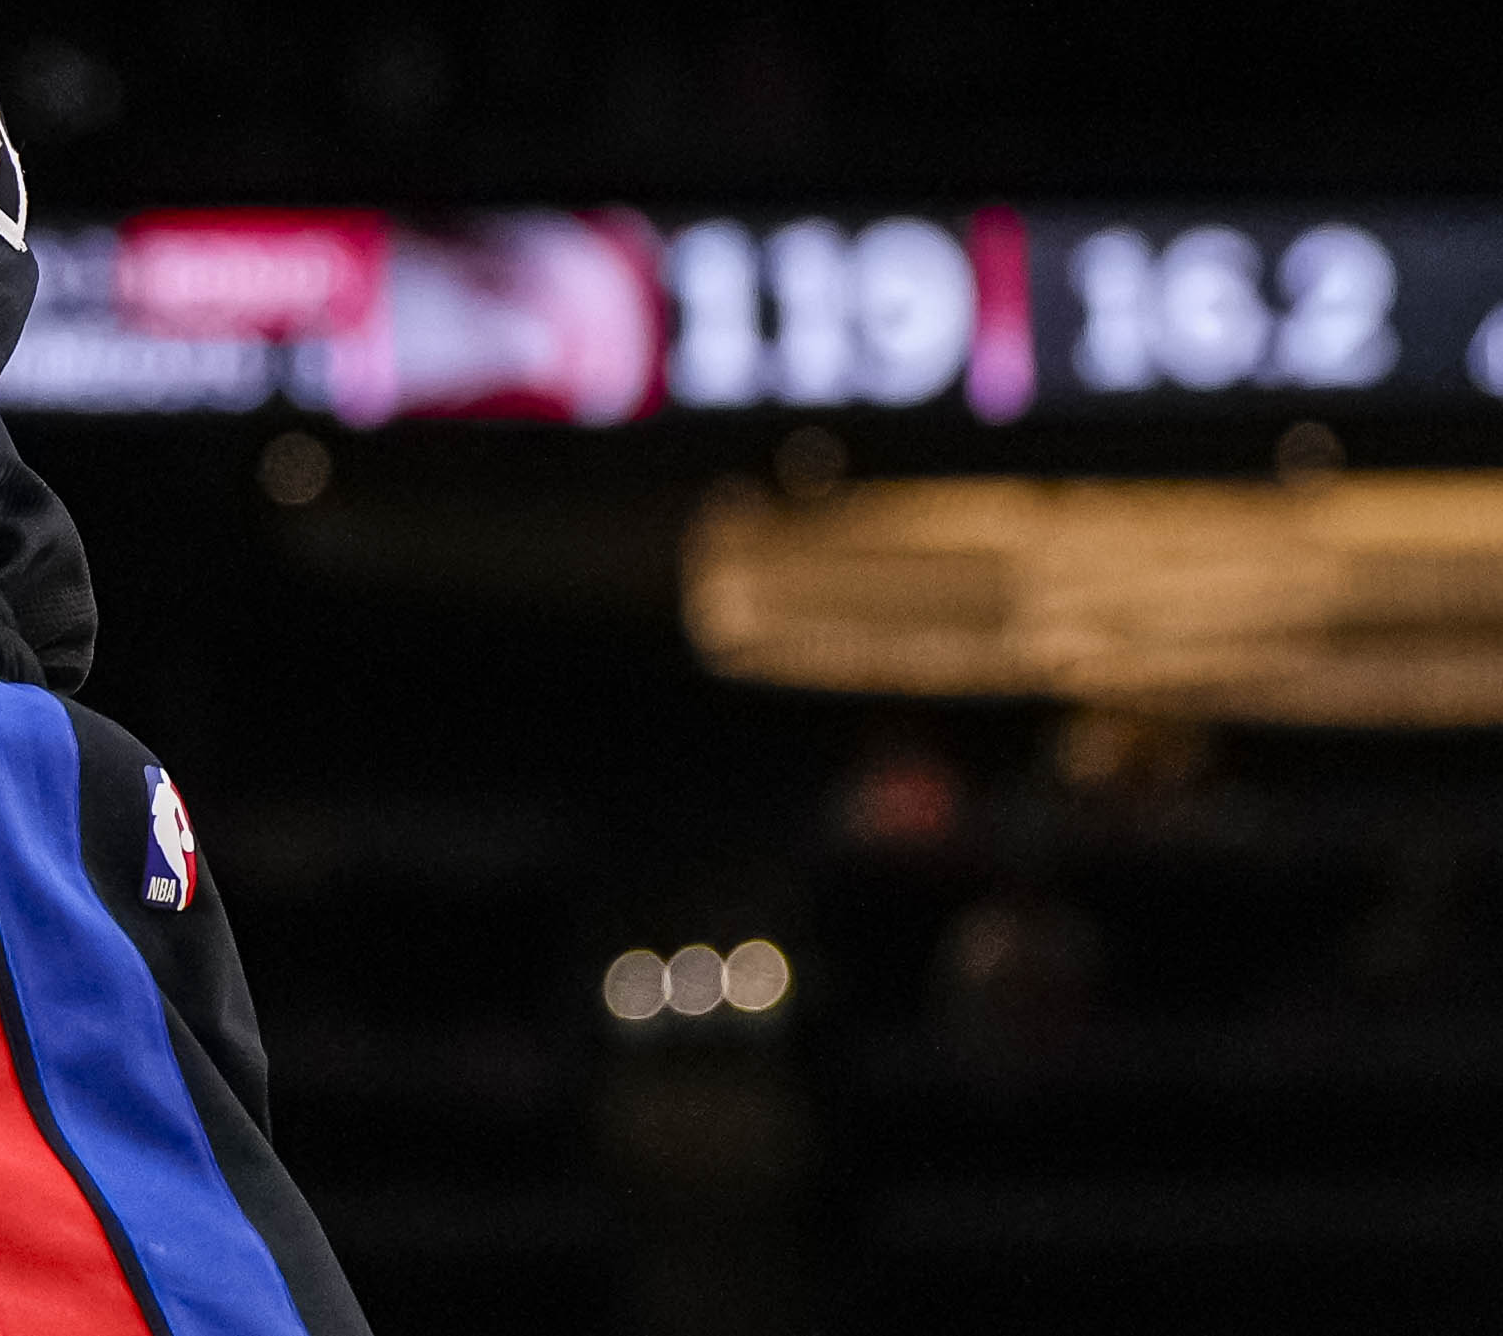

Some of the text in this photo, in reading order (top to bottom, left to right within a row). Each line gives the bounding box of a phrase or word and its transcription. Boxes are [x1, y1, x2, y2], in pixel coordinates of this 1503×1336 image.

[665, 217, 976, 409] 119
[1073, 222, 1397, 393] 16.2
[146, 875, 177, 904] NBA
